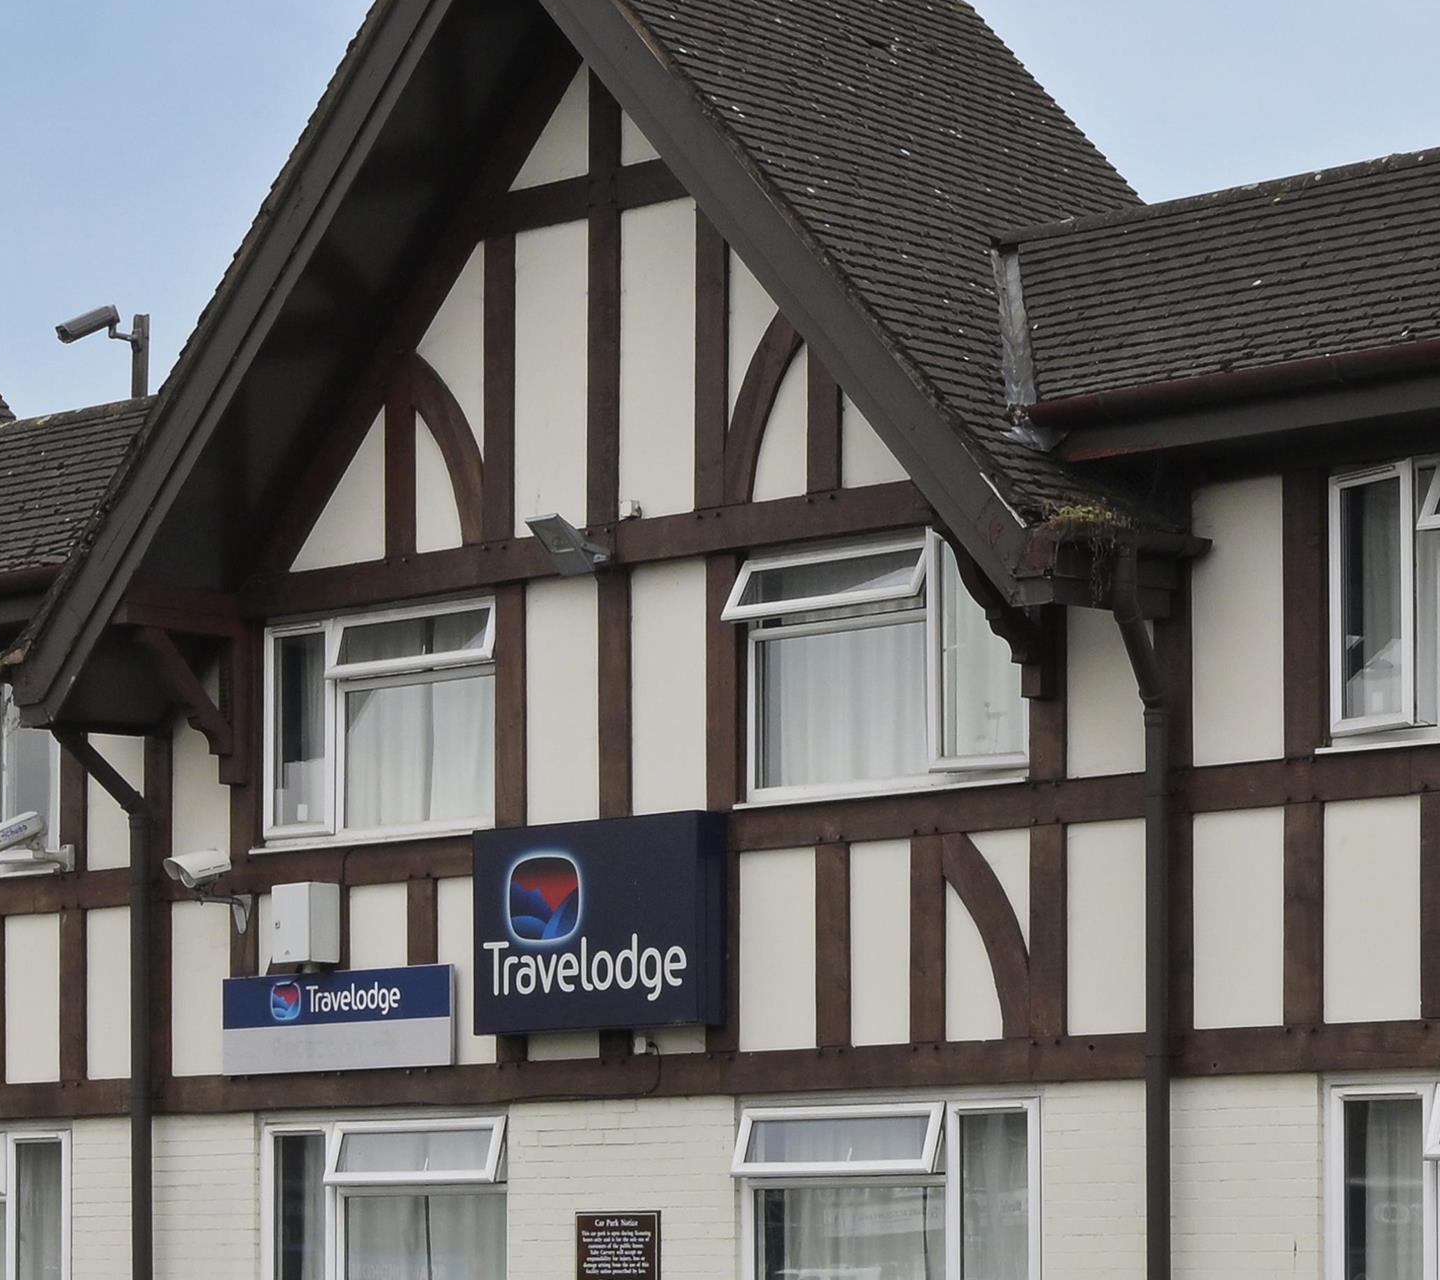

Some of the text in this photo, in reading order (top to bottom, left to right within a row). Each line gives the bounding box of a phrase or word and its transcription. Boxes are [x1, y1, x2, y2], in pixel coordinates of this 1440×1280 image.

[483, 933, 688, 1002] Travelodge
[305, 981, 401, 1015] Travelodge
[594, 1219, 605, 1227] Car
[606, 1219, 619, 1227] Park
